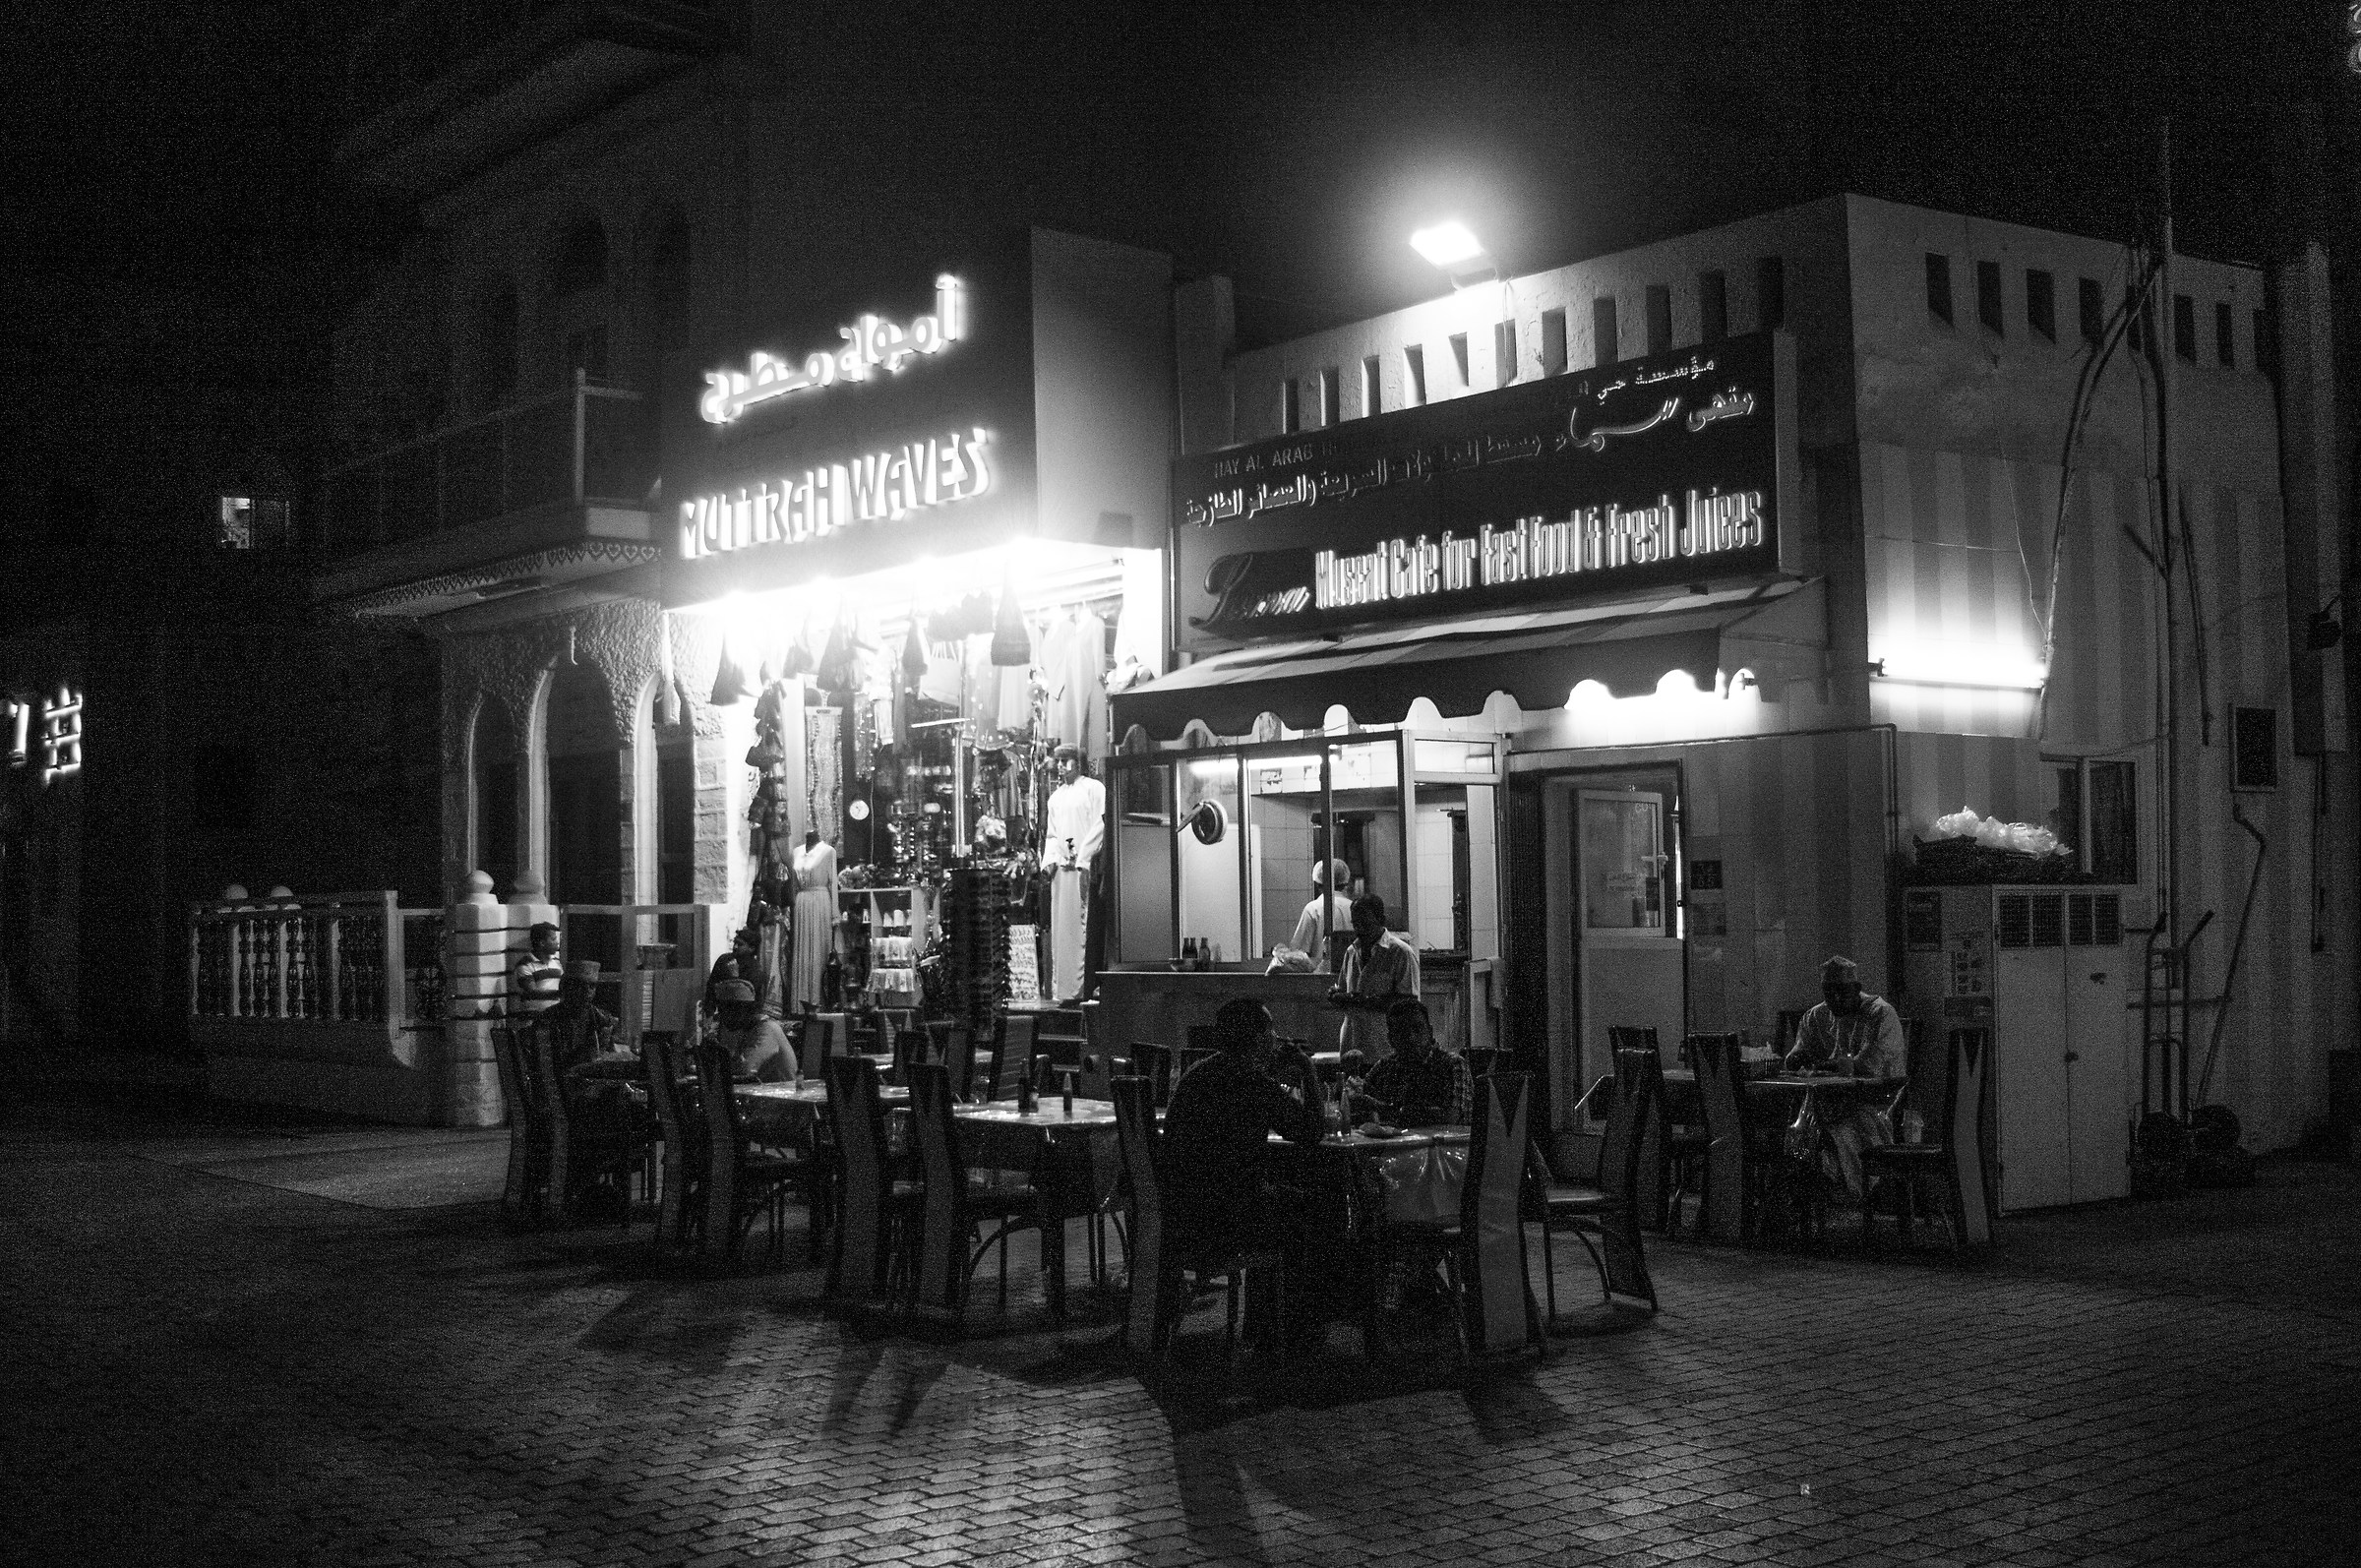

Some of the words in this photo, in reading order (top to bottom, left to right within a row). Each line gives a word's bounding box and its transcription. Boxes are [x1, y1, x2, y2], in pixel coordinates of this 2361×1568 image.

[1272, 444, 1313, 467] ARAB
[1314, 541, 1388, 610] Muscat
[1389, 534, 1439, 599] Cafe
[1441, 529, 1476, 590] for
[1479, 517, 1528, 585] Fast
[1528, 509, 1580, 579] Food
[1583, 506, 1602, 570] &
[1604, 494, 1675, 569] Fresh
[1679, 487, 1763, 557] Juices
